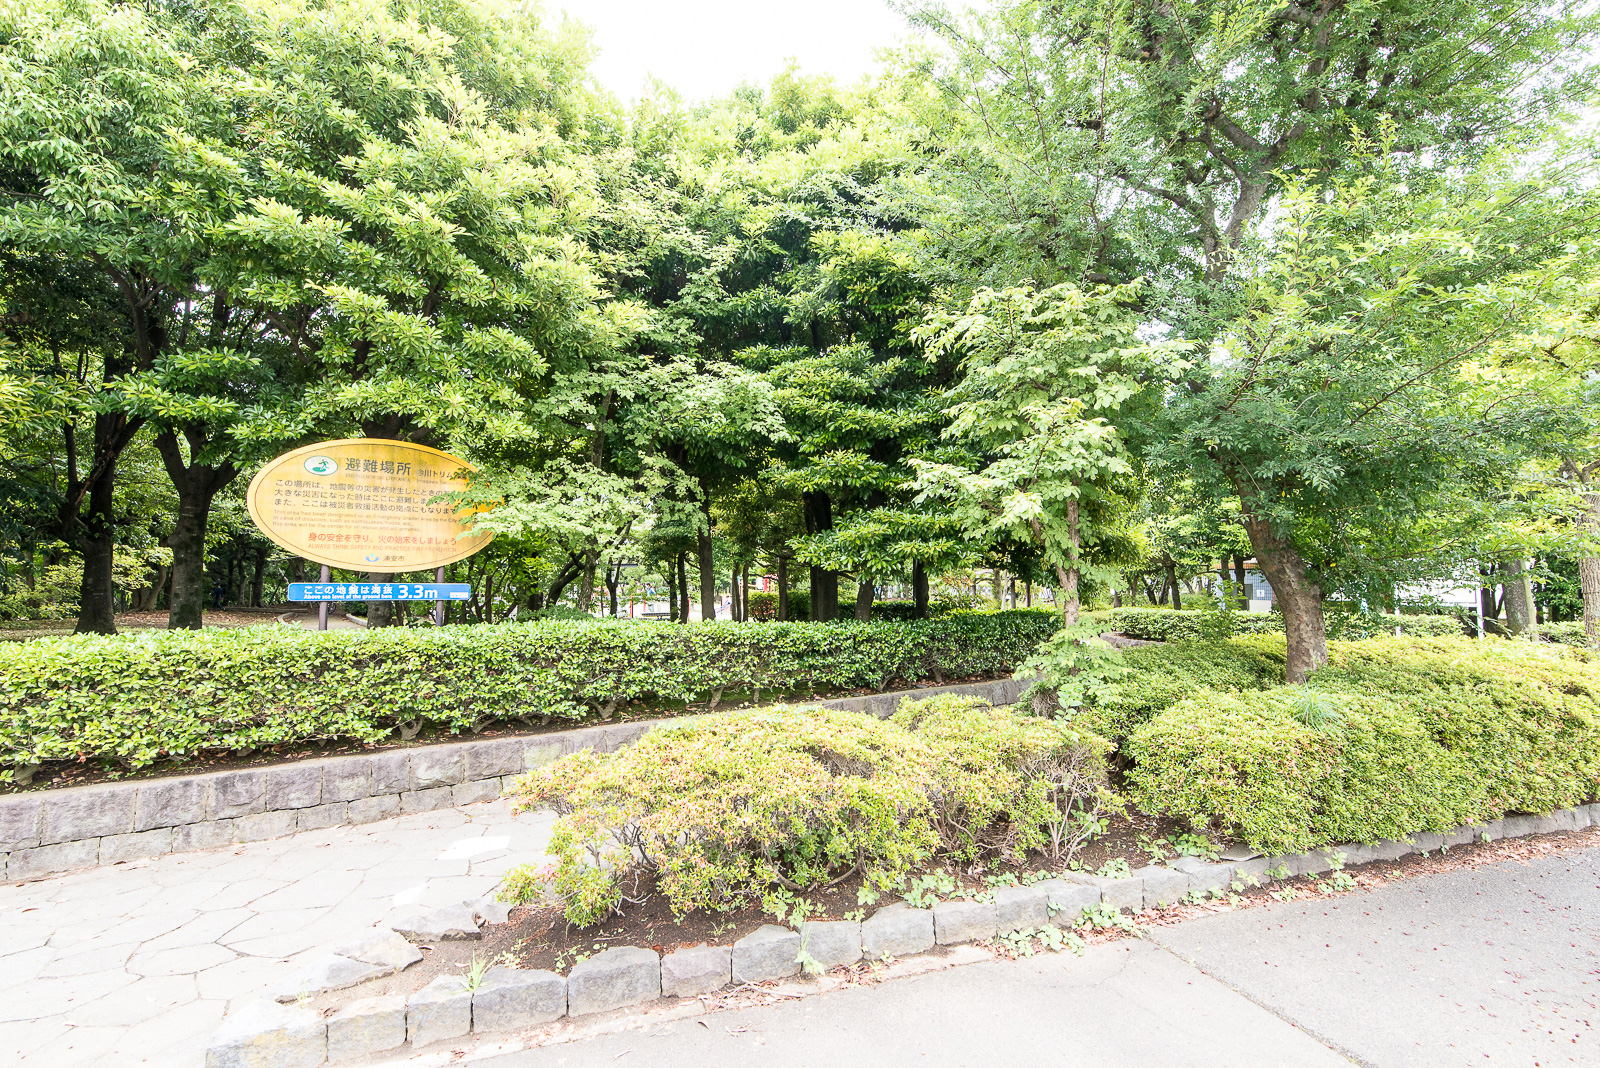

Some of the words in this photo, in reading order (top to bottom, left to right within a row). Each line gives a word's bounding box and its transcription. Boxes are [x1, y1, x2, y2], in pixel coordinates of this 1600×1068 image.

[345, 457, 411, 476] 避難場所
[417, 469, 466, 479] 今川トリム
[274, 489, 450, 506] 大きな災害になった時はここに避難しまう
[303, 585, 393, 595] ここの地盤は海抜
[397, 584, 438, 599] 3.3m
